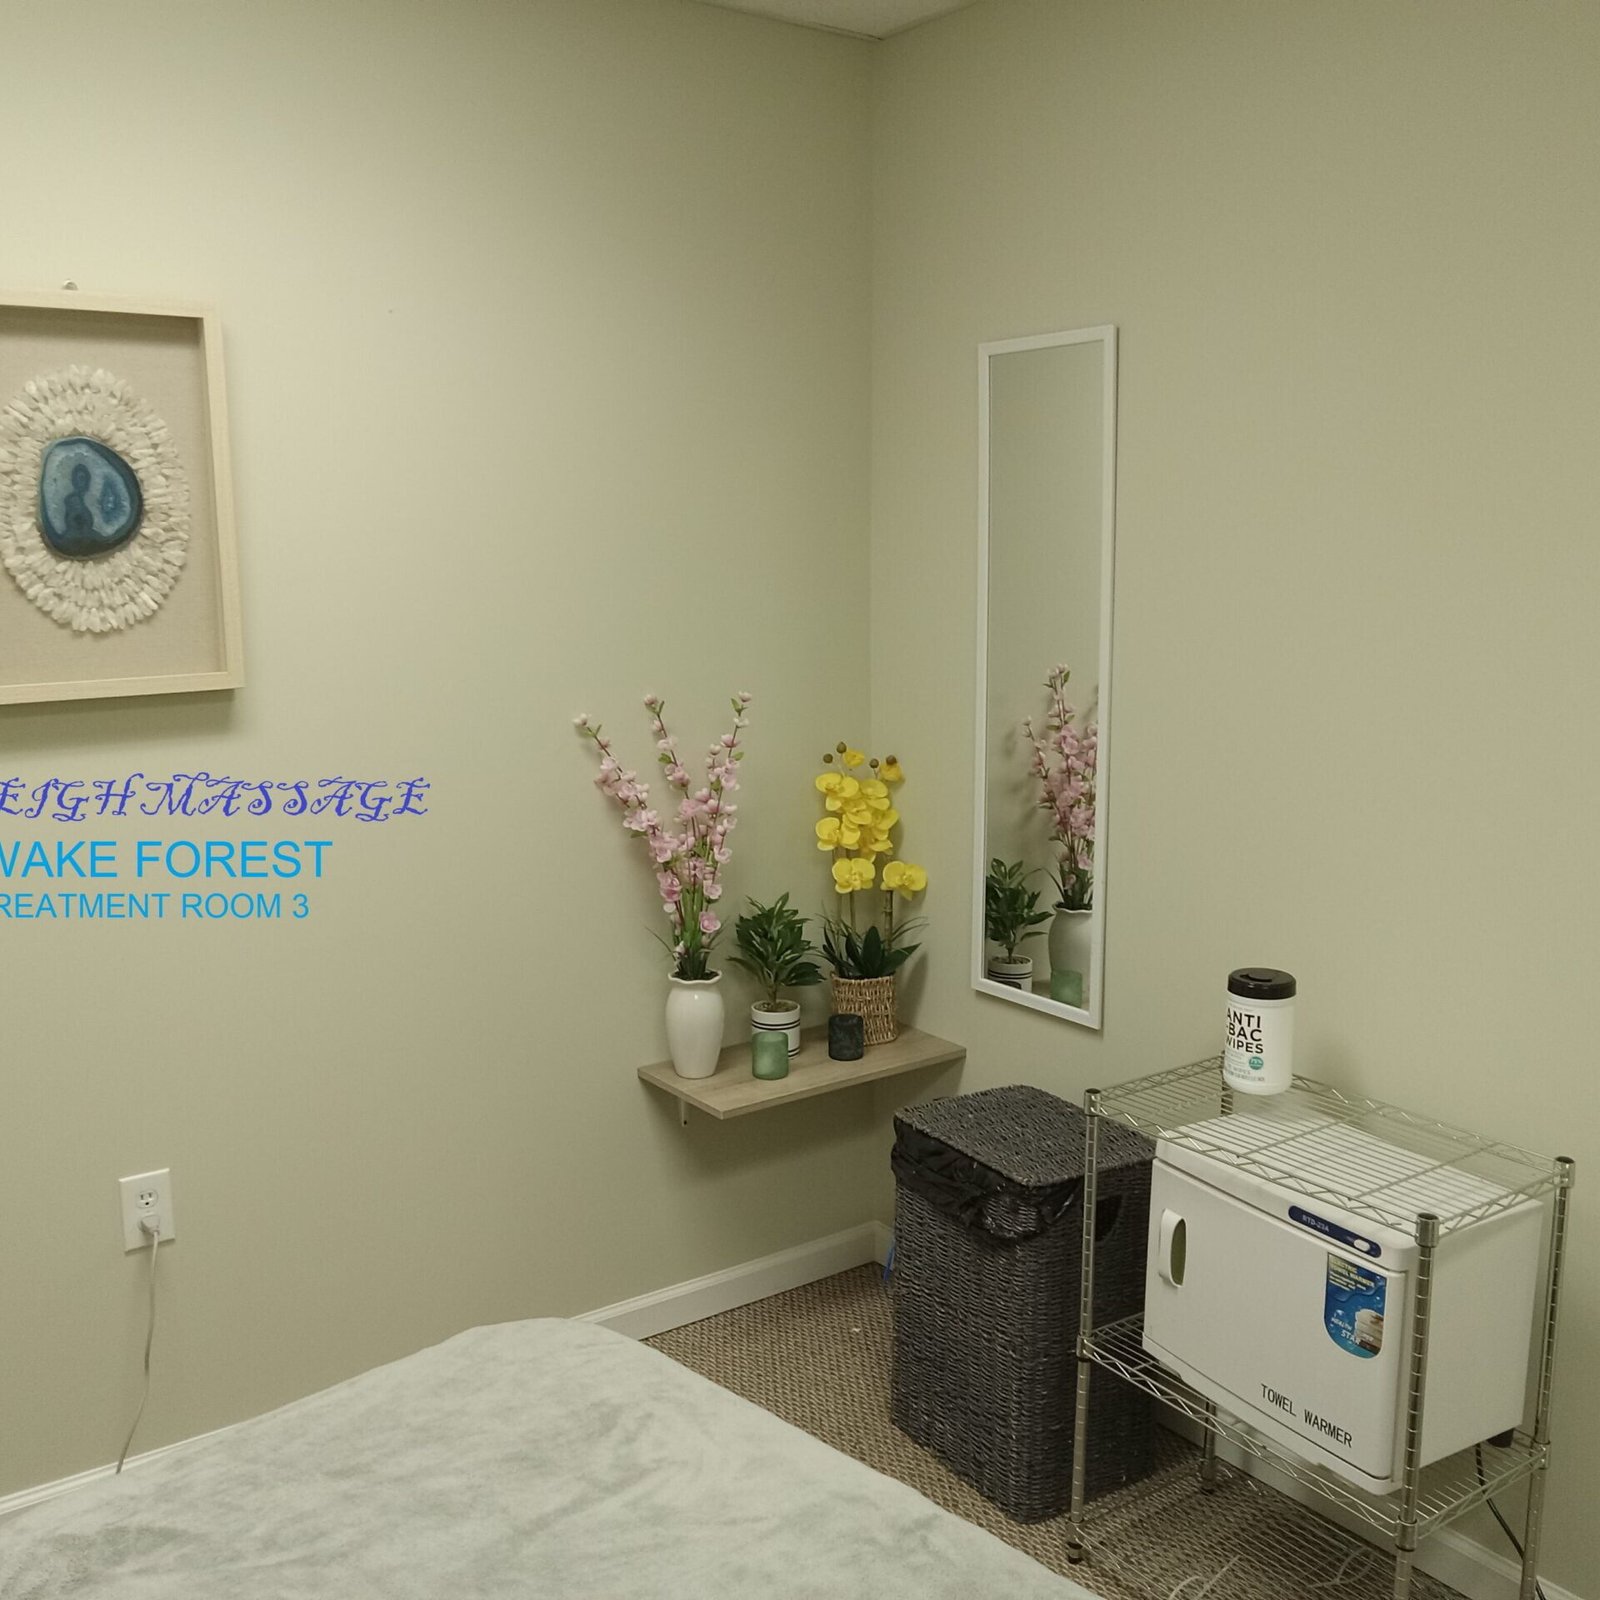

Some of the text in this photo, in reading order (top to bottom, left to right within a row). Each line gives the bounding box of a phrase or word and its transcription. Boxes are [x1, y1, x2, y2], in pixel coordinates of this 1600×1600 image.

[1226, 1007, 1261, 1028] ANTI
[1340, 1329, 1361, 1345] STAR
[1261, 1383, 1353, 1448] TOWEL WARMER
